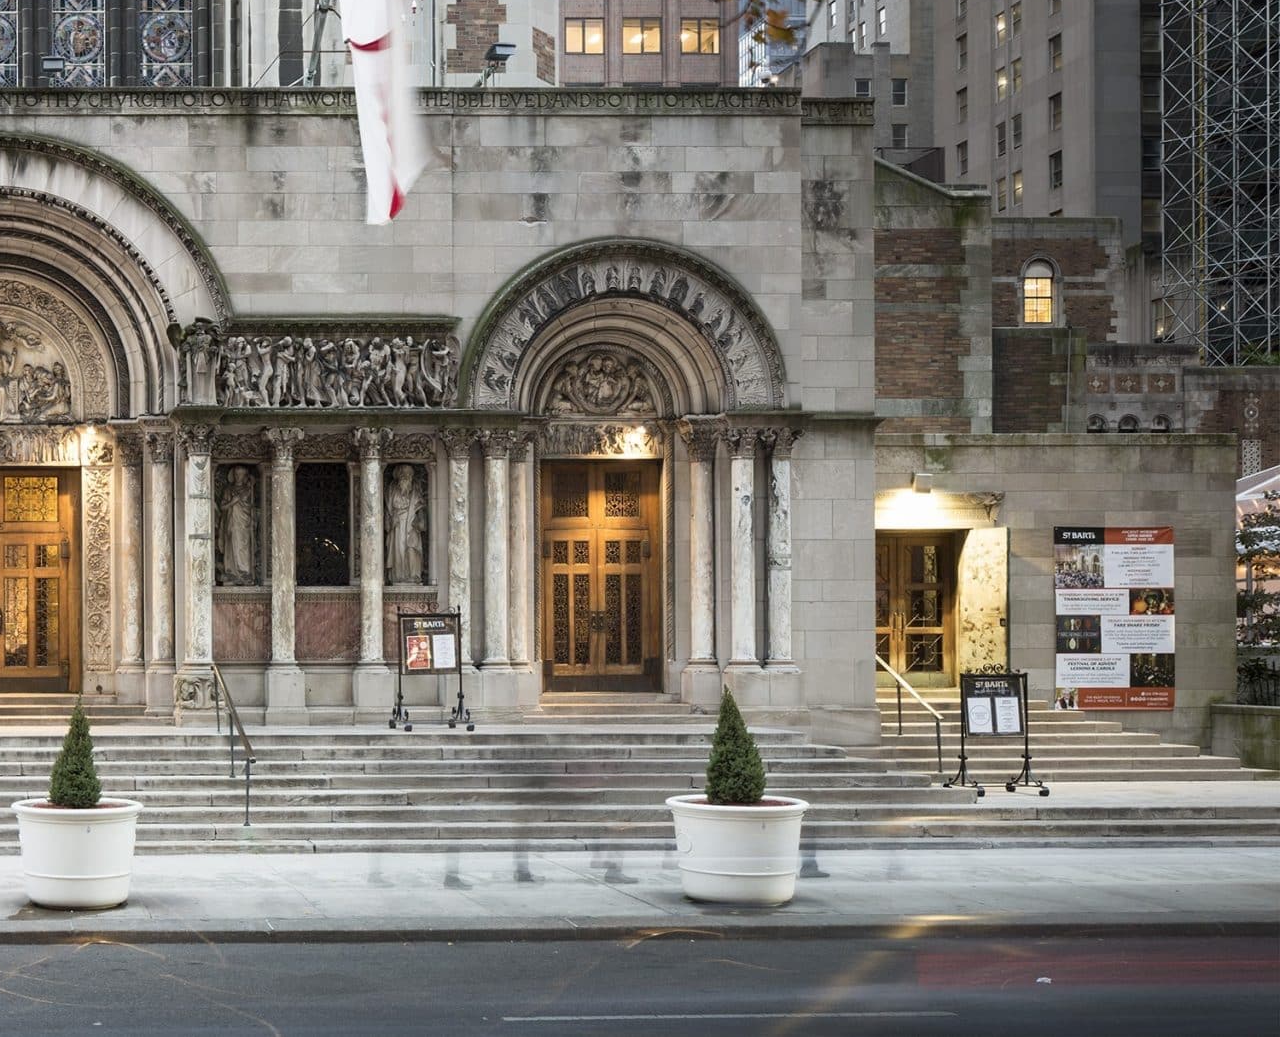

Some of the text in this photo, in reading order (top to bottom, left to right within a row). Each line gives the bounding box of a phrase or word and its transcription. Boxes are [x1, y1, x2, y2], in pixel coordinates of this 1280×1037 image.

[40, 92, 82, 108] THY
[87, 92, 165, 108] CHVRCH
[167, 92, 196, 108] TO
[200, 91, 250, 107] LOVE
[252, 91, 301, 107] THAT
[456, 92, 549, 108] BELIEVED
[551, 92, 592, 108] AND
[596, 92, 649, 108] BOTH
[651, 92, 678, 108] TO
[681, 92, 754, 108] PREACH
[757, 92, 798, 108] AND
